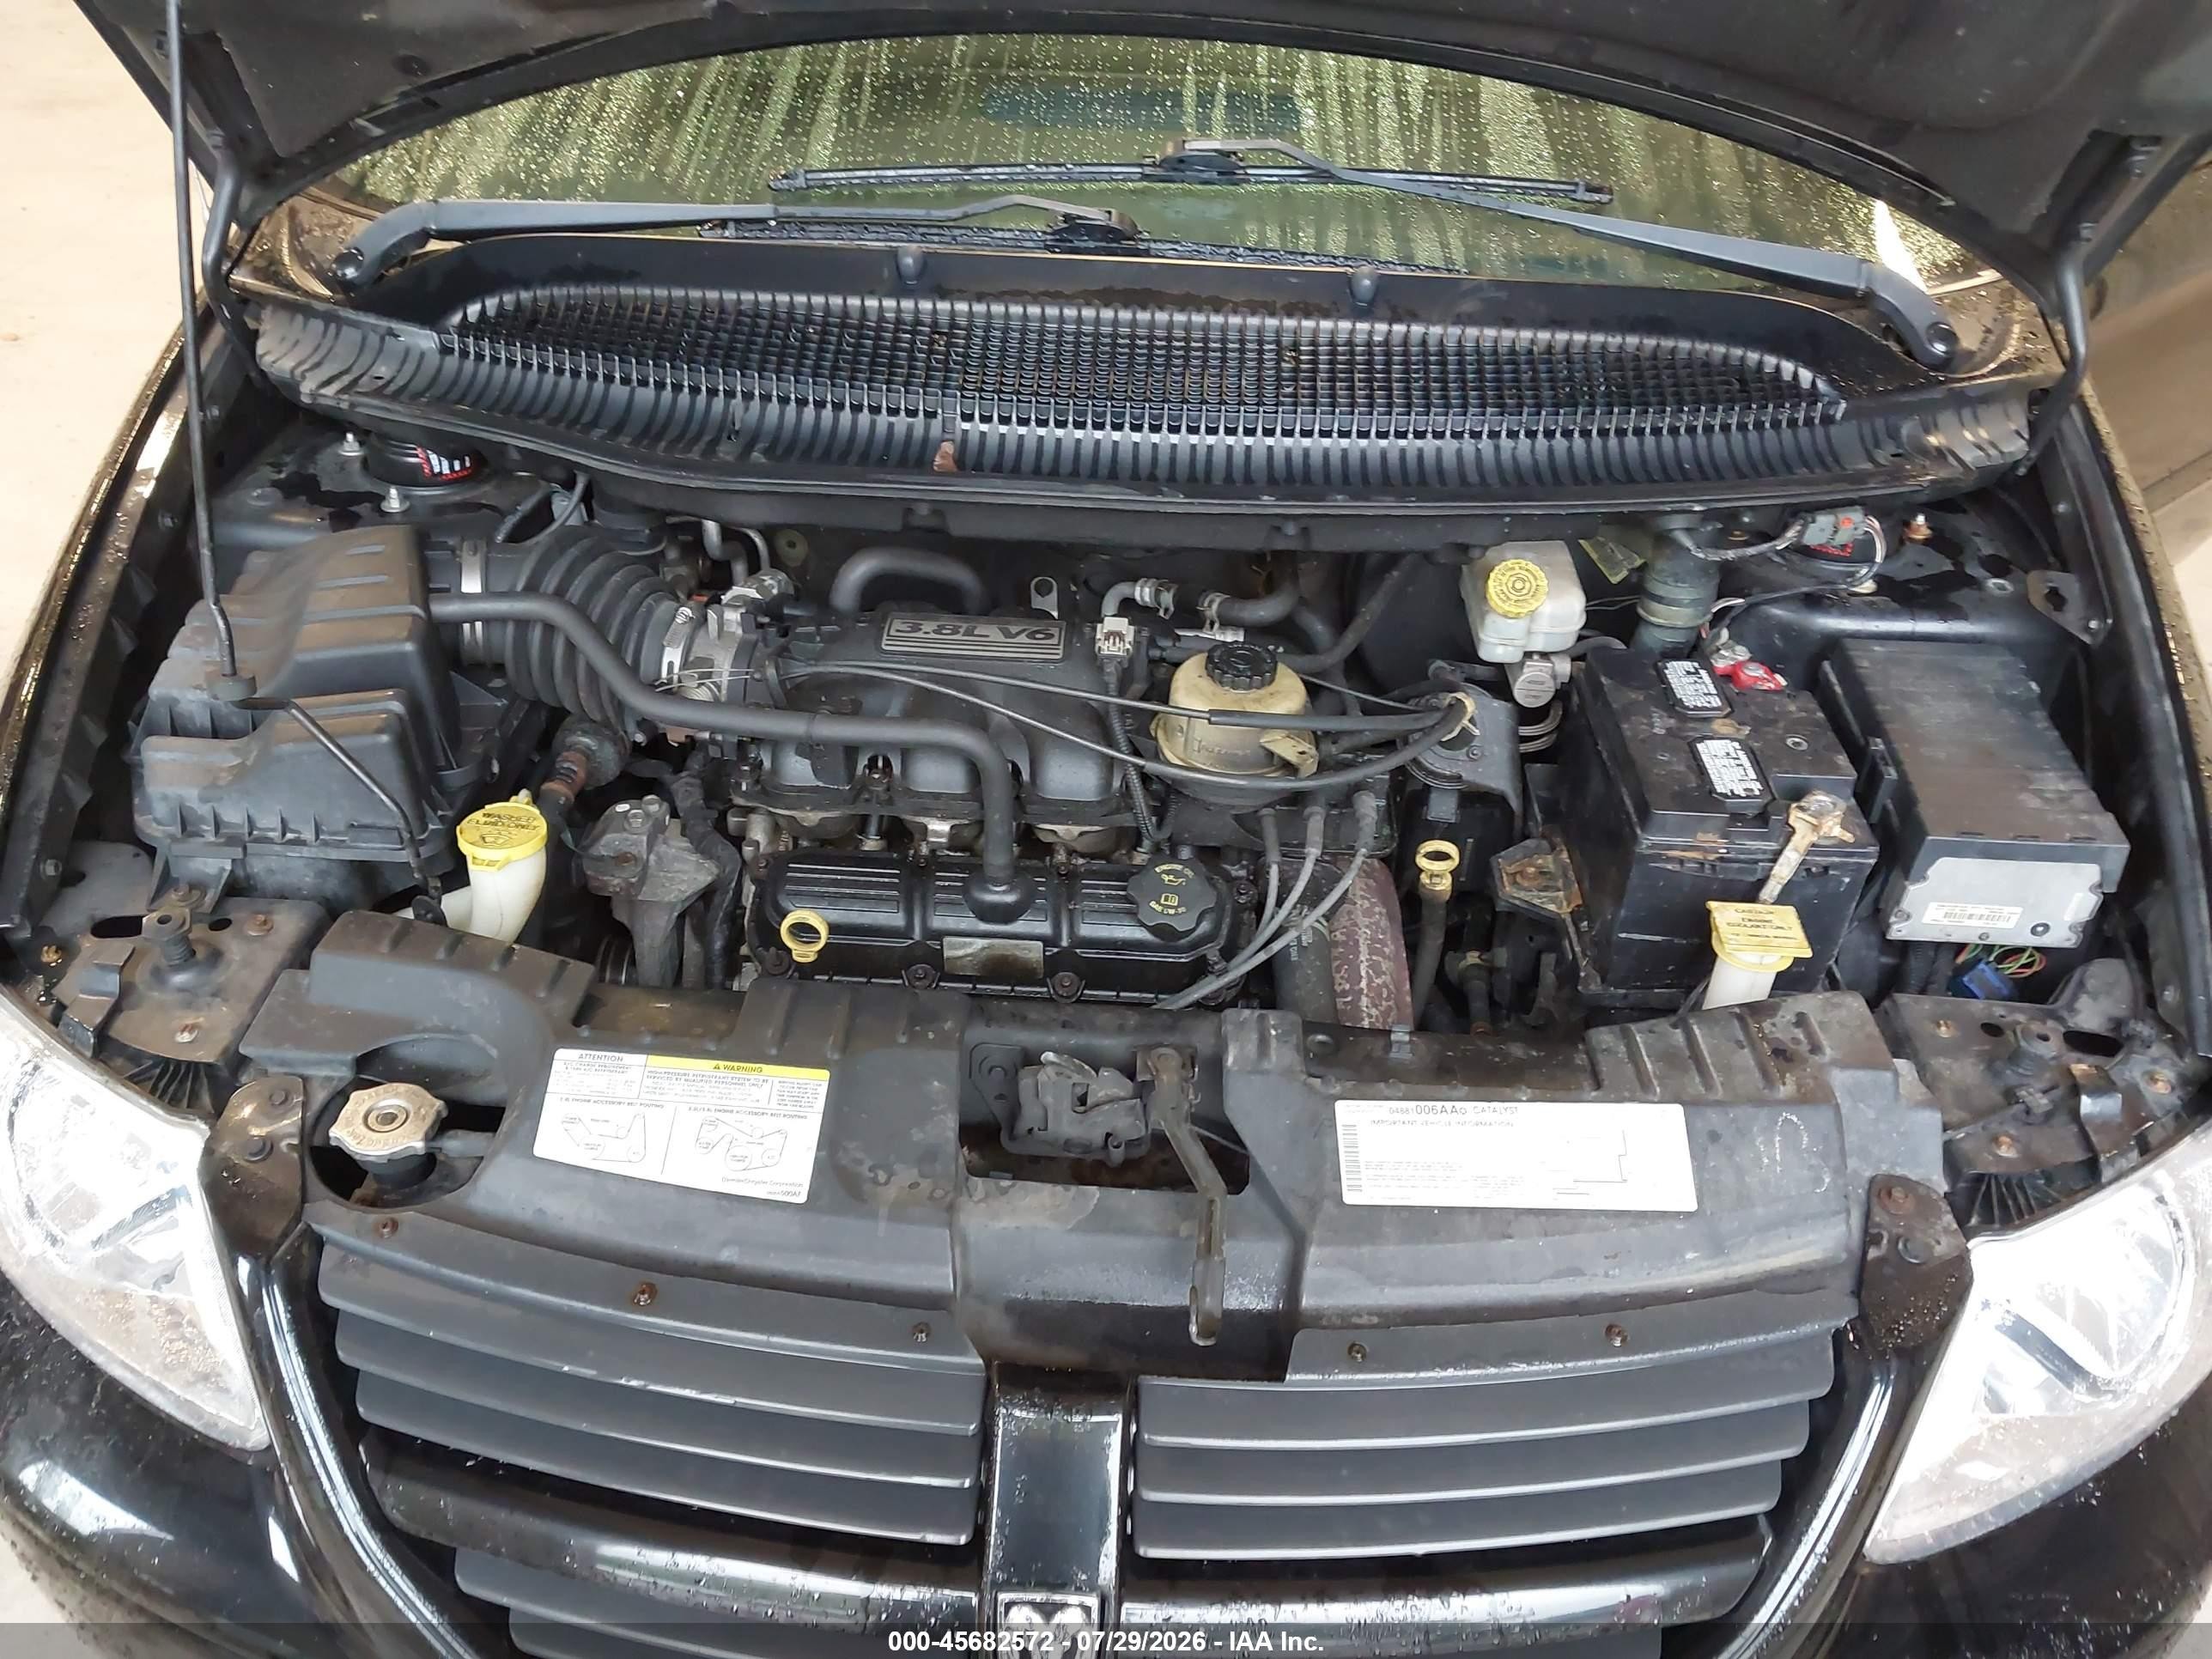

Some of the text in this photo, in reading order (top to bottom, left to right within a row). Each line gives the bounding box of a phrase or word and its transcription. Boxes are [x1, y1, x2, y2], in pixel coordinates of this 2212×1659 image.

[896, 622, 1055, 641] 3.8L V6
[482, 812, 536, 823] WASHER
[466, 817, 540, 831] FLUID ONLY
[579, 1053, 623, 1062] ATTENTION
[723, 1064, 763, 1073] WARNING
[1473, 1105, 1518, 1115] CATALYST
